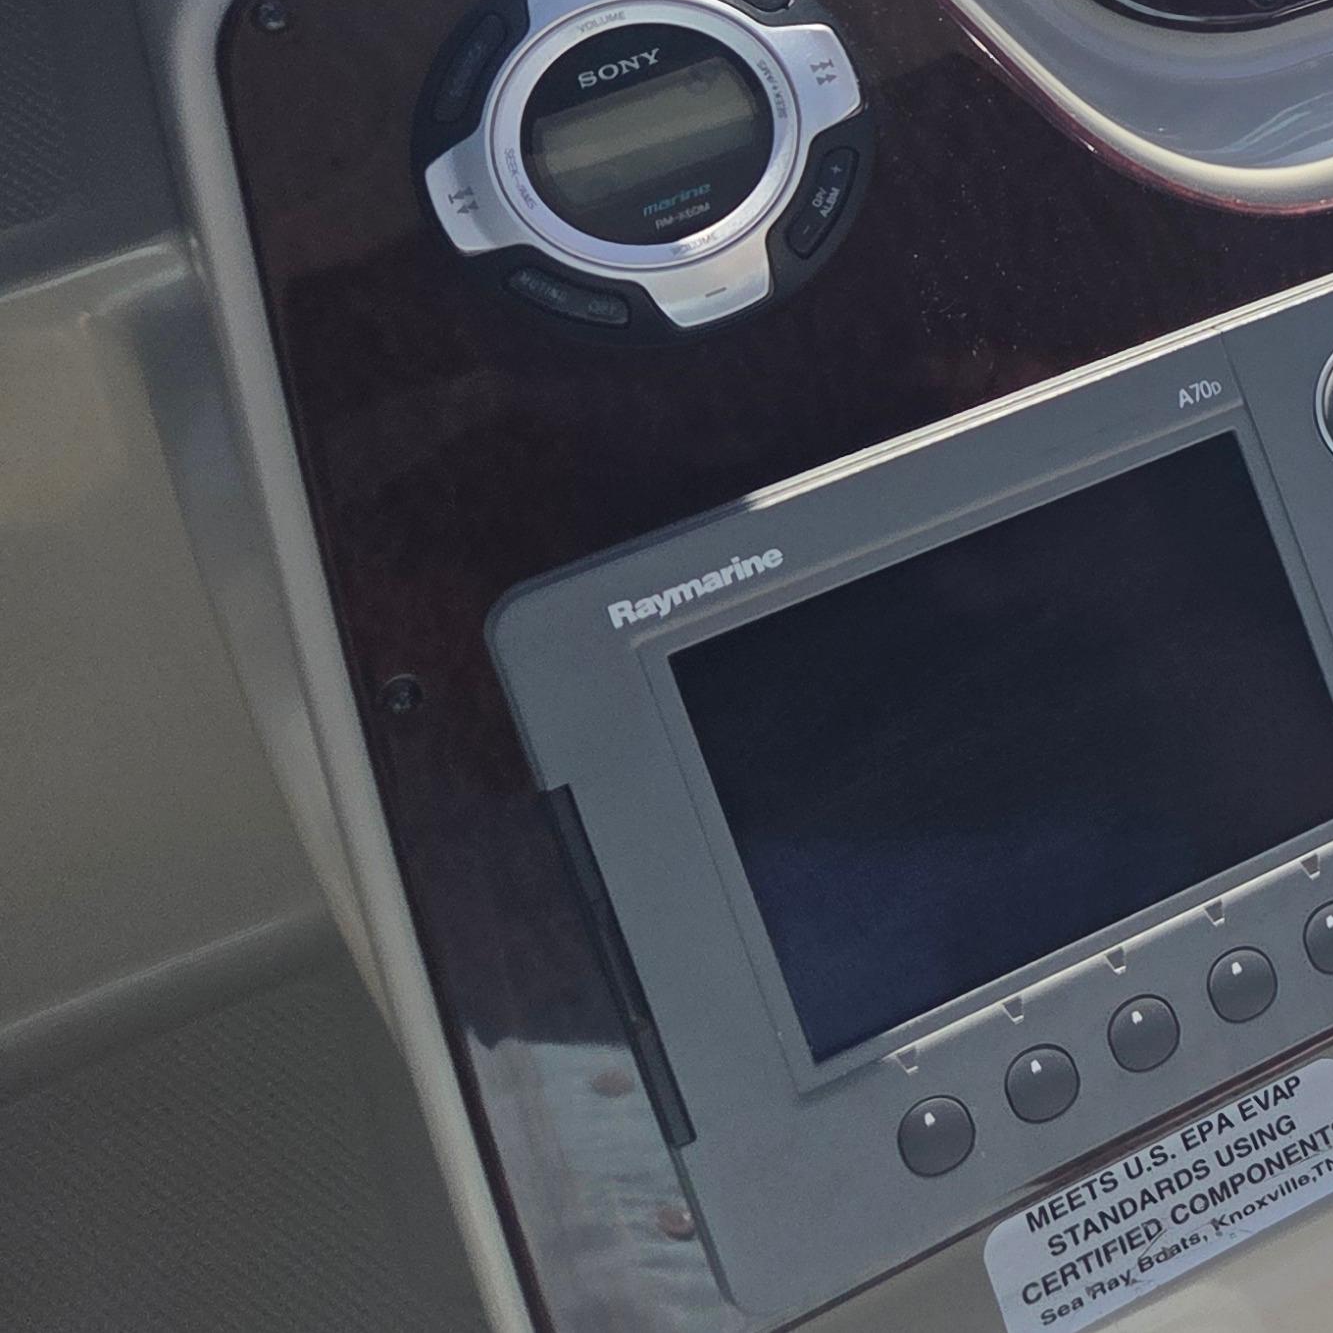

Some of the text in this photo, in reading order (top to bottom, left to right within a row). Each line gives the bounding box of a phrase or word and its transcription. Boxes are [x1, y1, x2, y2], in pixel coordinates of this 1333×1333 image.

[576, 10, 627, 33] VOLUME
[577, 47, 660, 90] SONY
[643, 183, 711, 217] marine
[1177, 379, 1223, 409] A70D
[606, 543, 785, 629] Raymarine
[1026, 1076, 1300, 1232] MEETS U.S. EPA EVAP
[1049, 1115, 1295, 1255] STANDARDS USING
[1021, 1217, 1163, 1305] CERTIFIED
[1041, 1297, 1084, 1325] Sea
[1089, 1269, 1134, 1299] Ray
